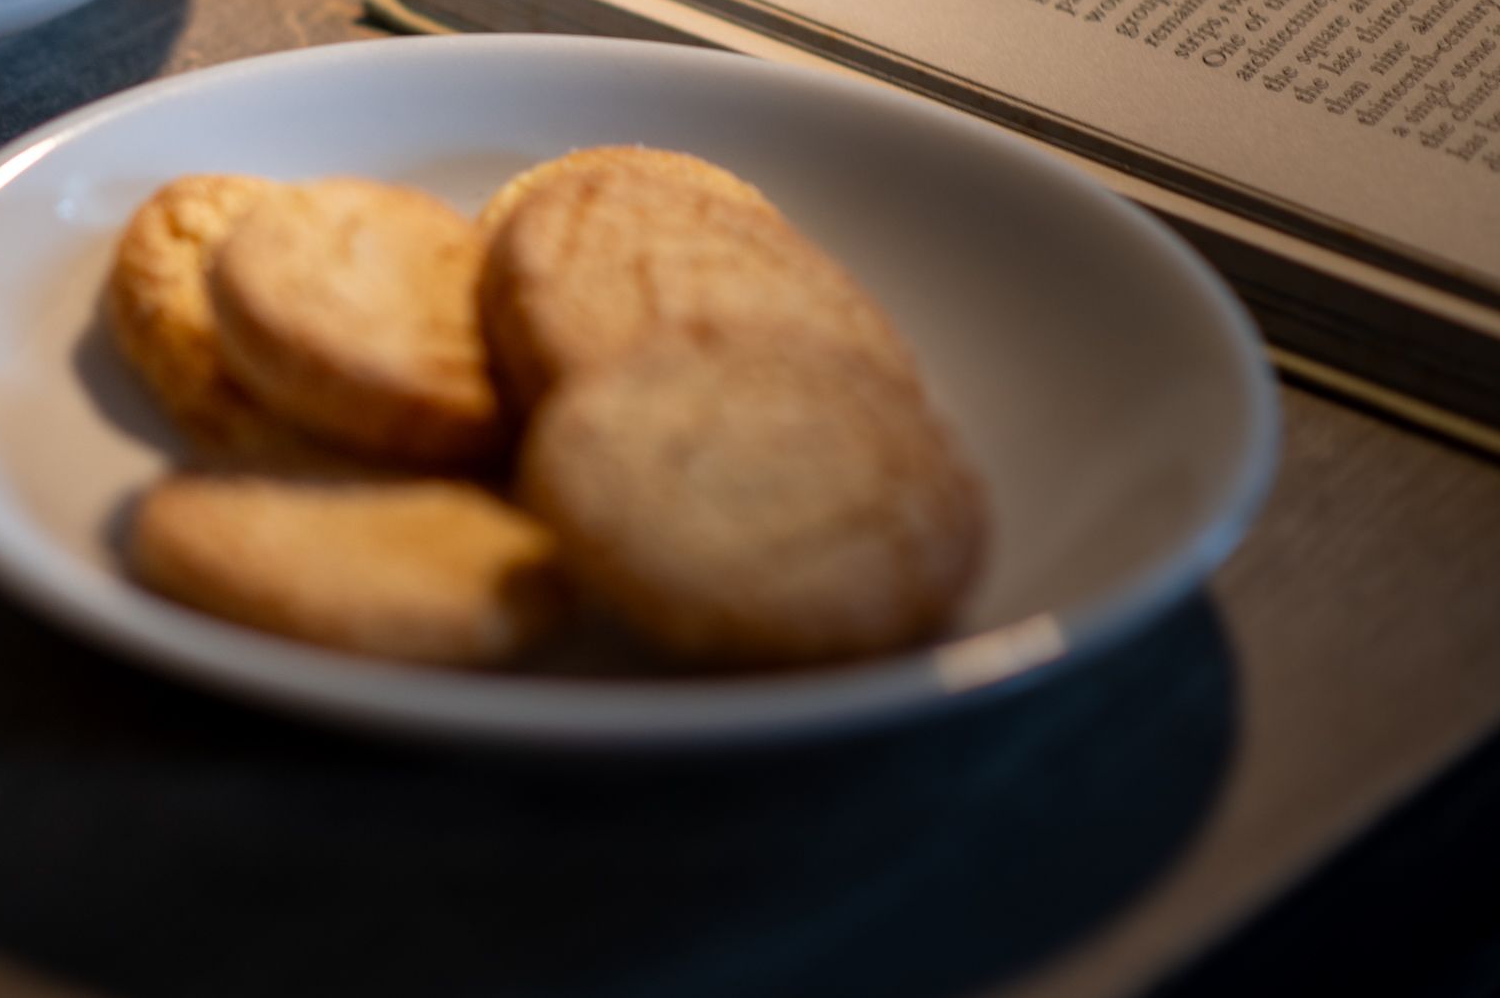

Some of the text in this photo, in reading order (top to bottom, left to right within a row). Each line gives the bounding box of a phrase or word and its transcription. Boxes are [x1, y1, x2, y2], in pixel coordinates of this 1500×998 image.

[1173, 15, 1230, 60] strips,
[1200, 33, 1246, 68] One
[1244, 6, 1268, 32] of
[1261, 65, 1298, 93] the
[1295, 14, 1351, 65] square
[1292, 77, 1329, 104] the
[1319, 45, 1362, 77] late
[1323, 80, 1370, 115] than
[1368, 39, 1410, 76] nine
[1404, 79, 1455, 124] single
[1450, 37, 1497, 80] stone
[1417, 121, 1455, 150] the
[1445, 133, 1488, 163] has
